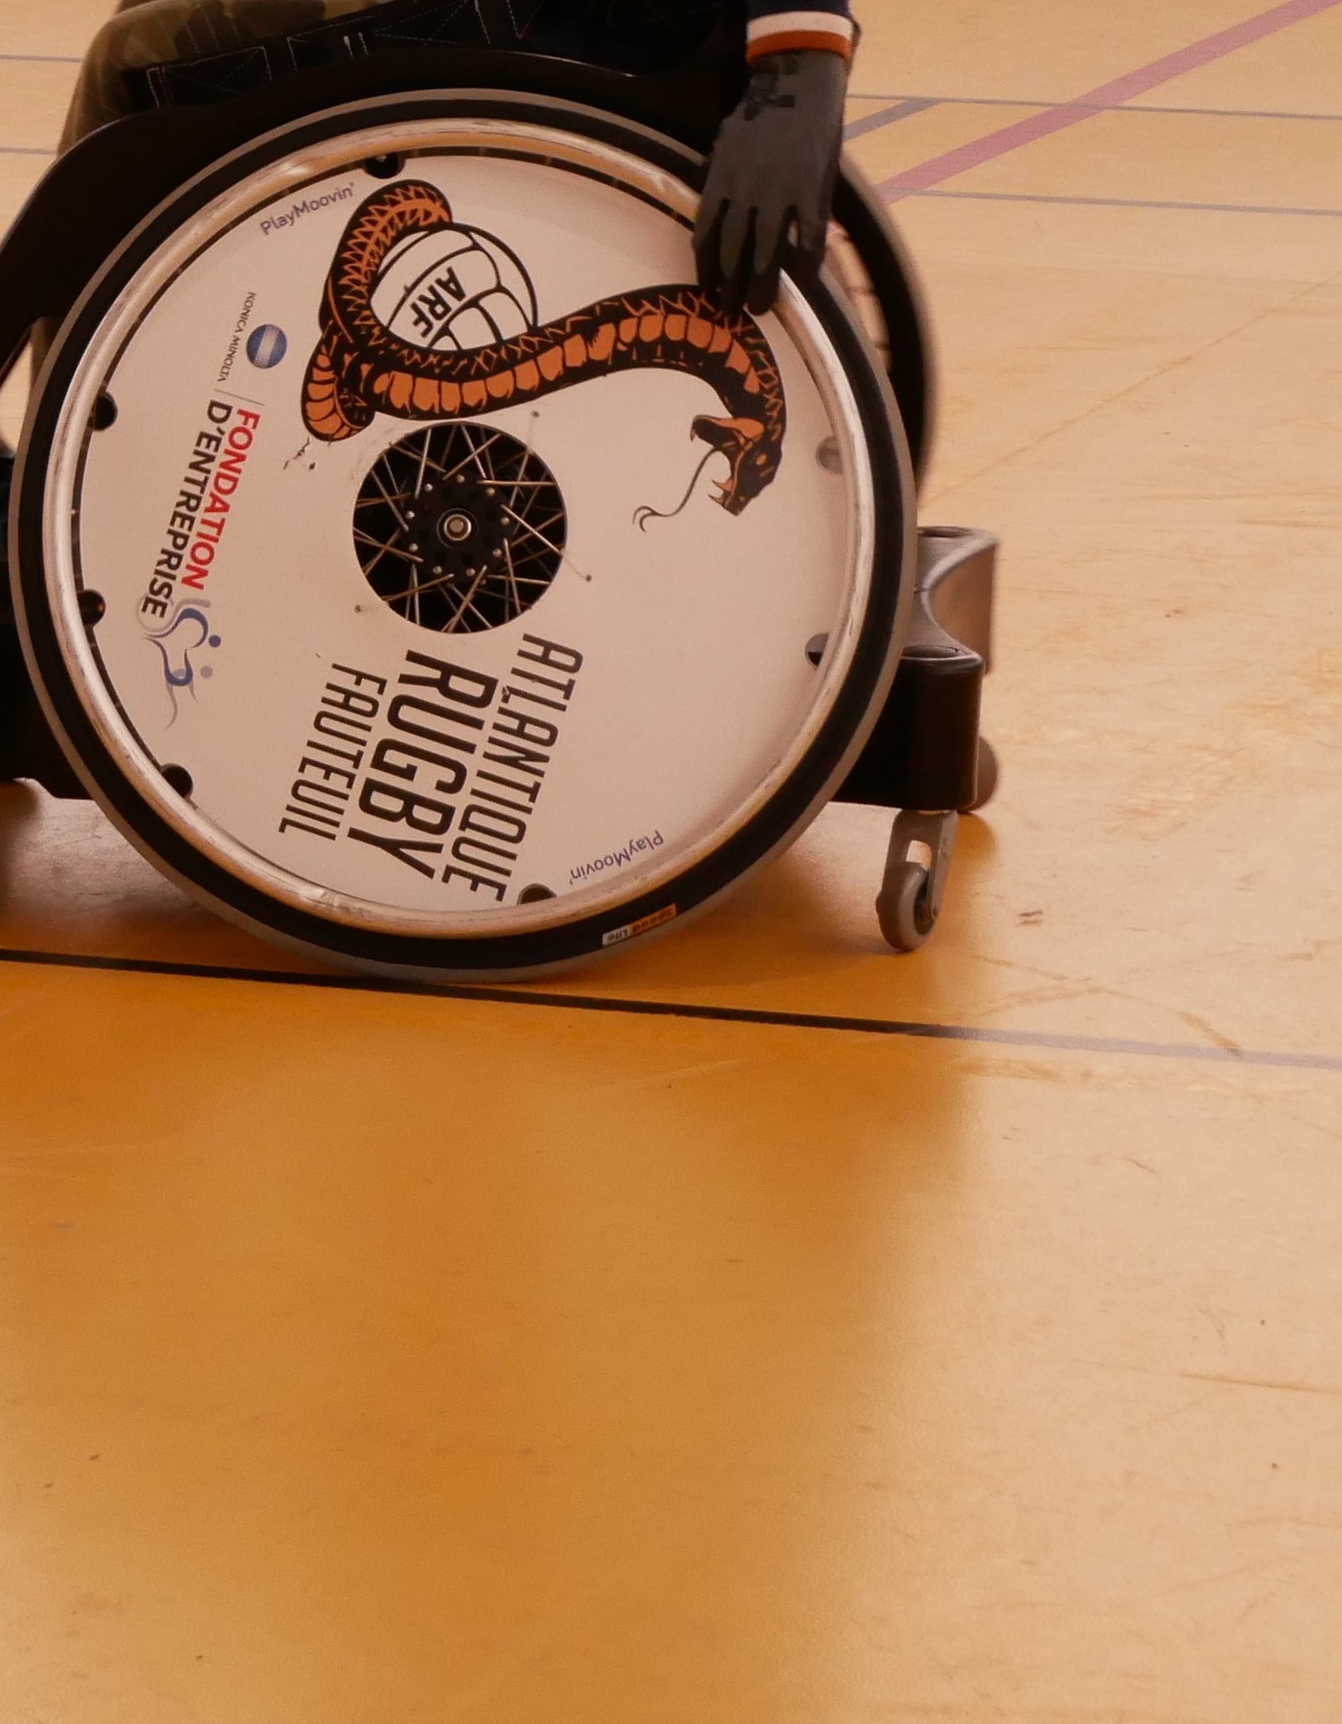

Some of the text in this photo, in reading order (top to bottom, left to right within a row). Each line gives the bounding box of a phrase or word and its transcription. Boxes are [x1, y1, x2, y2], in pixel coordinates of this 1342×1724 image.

[217, 291, 256, 383] KONICA MINOLTA
[410, 266, 466, 338] ARF
[141, 399, 234, 619] D'ENTREPRISE
[181, 408, 261, 591] FONDATION
[278, 662, 388, 841] FAUTEUIL
[347, 649, 499, 880] RUGBY
[441, 633, 584, 902] ATLANTIQUE
